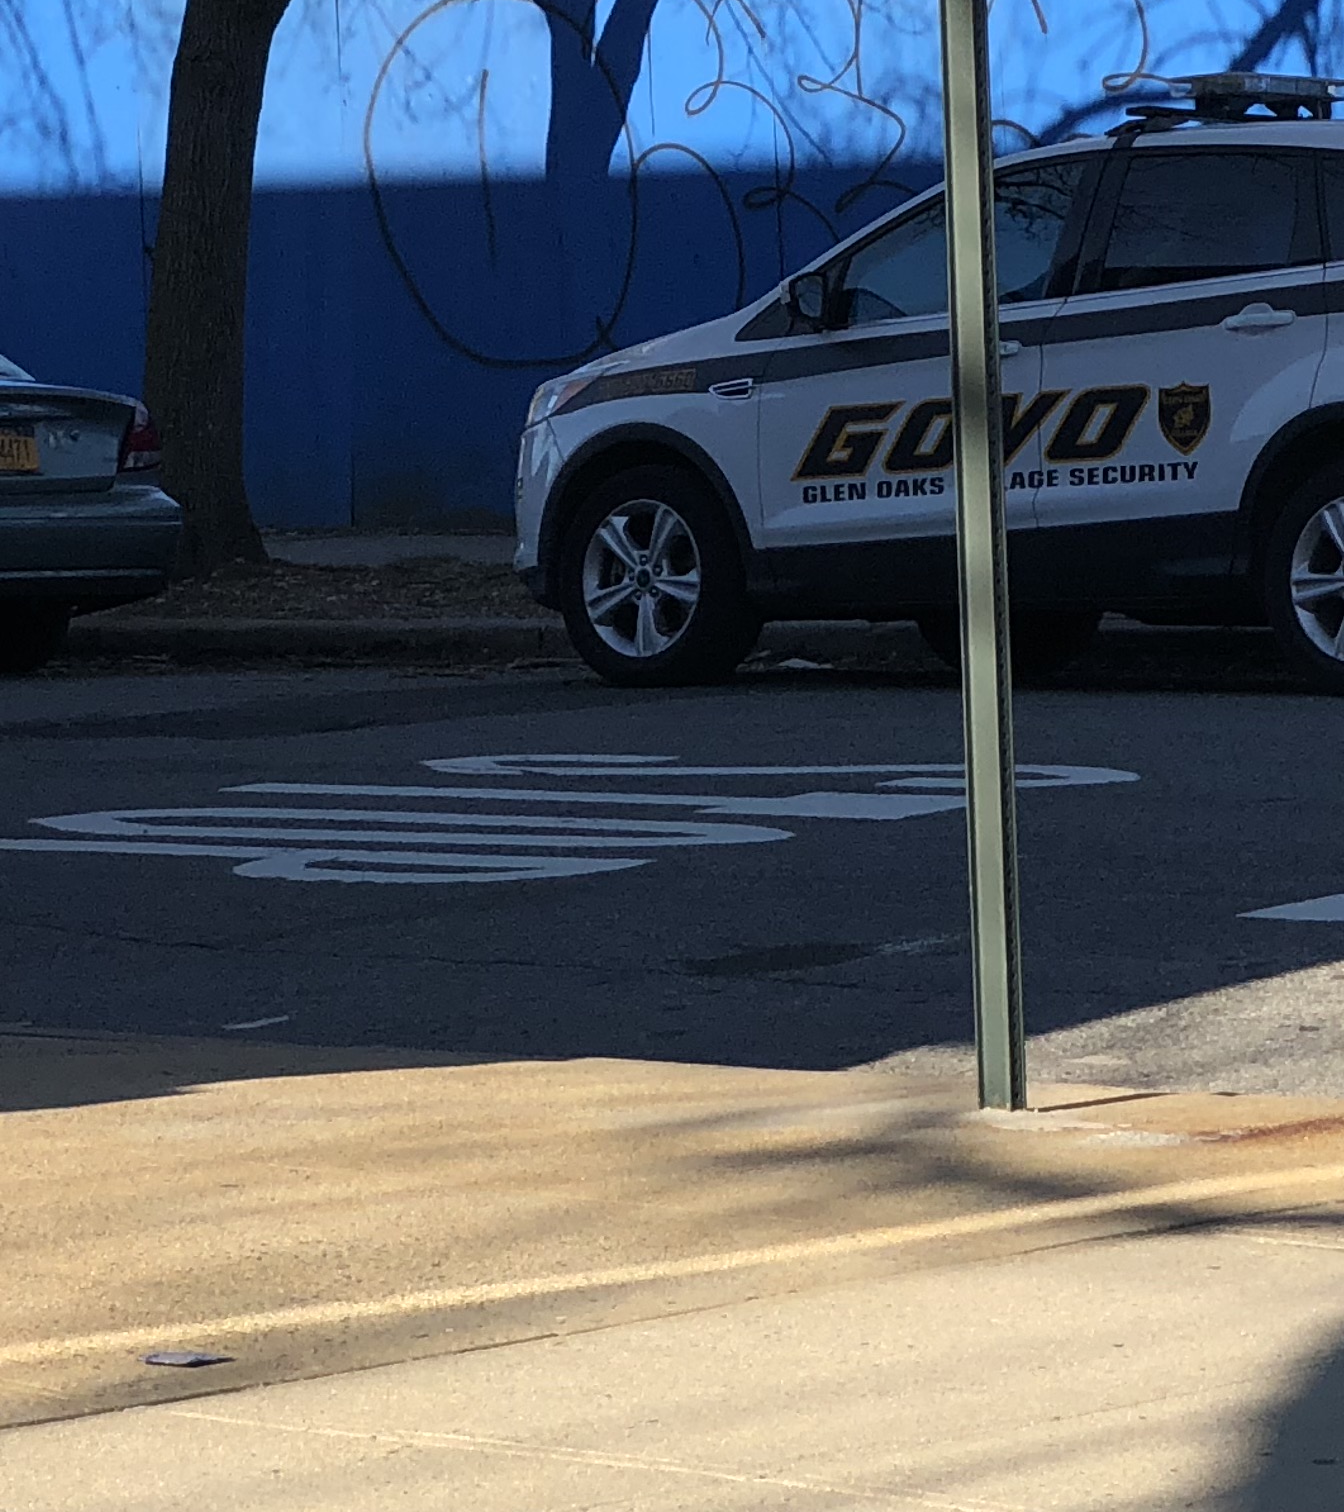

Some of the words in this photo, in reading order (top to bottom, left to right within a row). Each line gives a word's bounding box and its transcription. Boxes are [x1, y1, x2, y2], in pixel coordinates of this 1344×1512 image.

[802, 482, 867, 504] GLEN
[877, 476, 945, 498] OAKS
[1005, 470, 1059, 491] AGE
[1069, 462, 1198, 486] SECURITY
